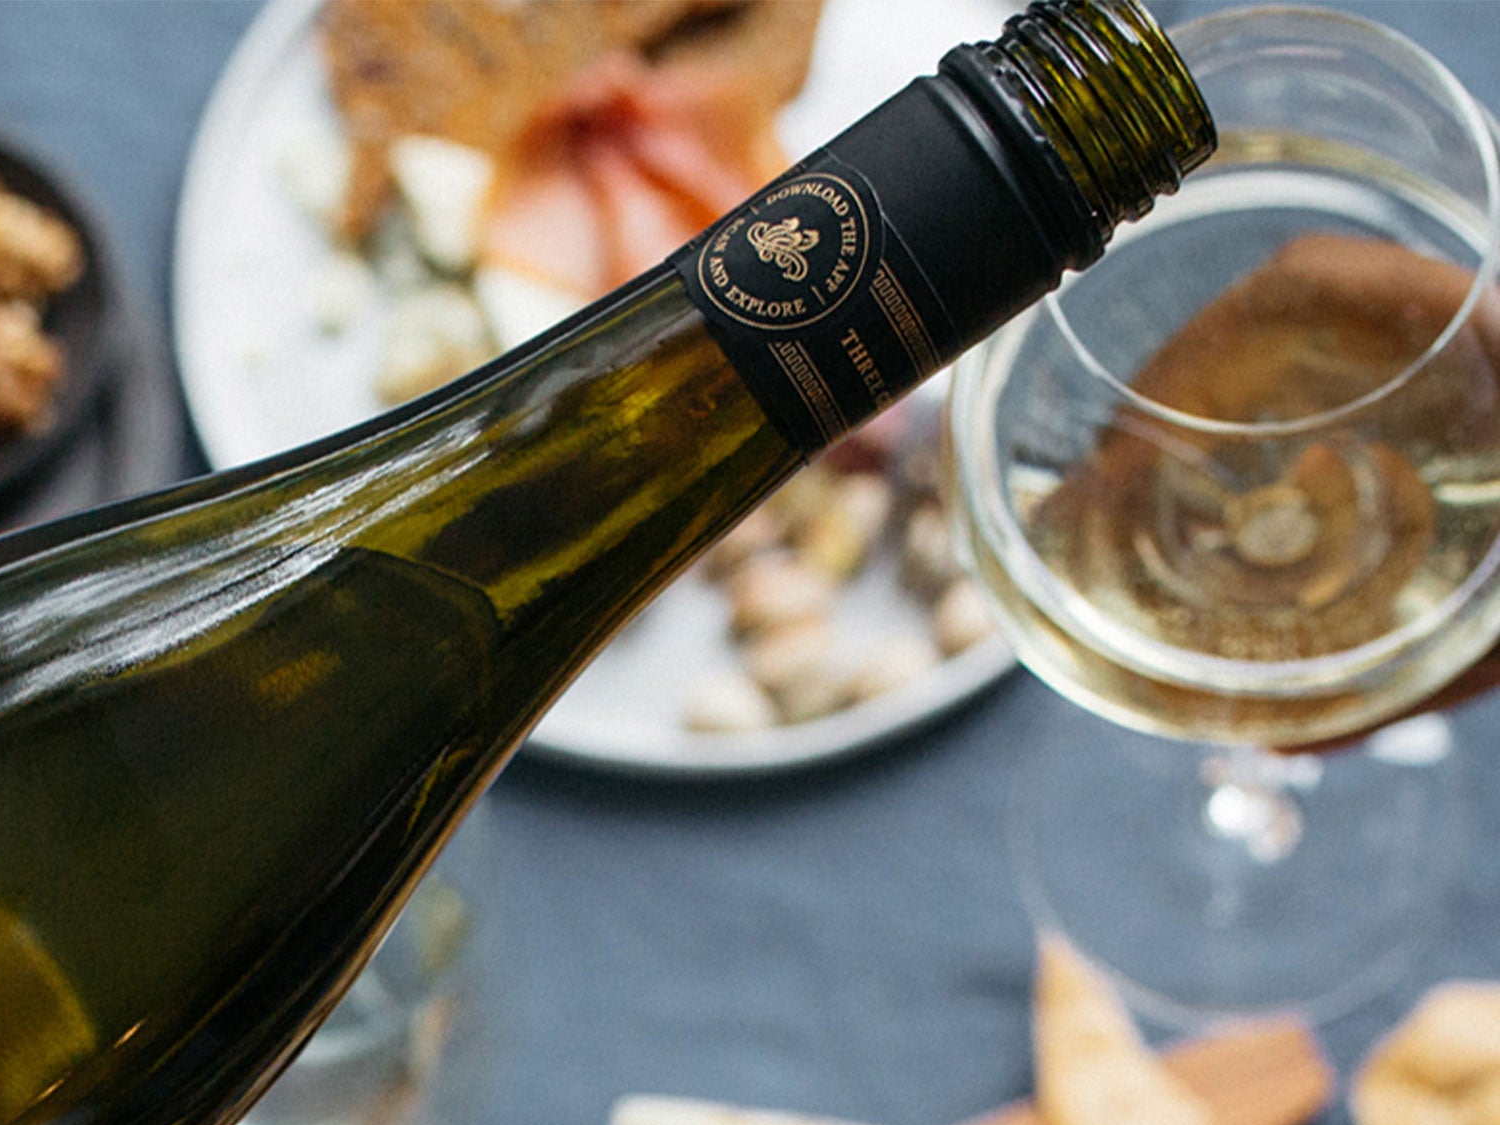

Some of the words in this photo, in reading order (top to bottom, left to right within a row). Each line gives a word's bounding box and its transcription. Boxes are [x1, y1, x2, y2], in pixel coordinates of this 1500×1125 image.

[765, 182, 848, 216] DOWNLOAD
[840, 217, 857, 257] THE
[710, 257, 729, 288] AND
[725, 286, 806, 317] EXPLORE
[826, 257, 851, 293] APP
[840, 328, 885, 395] THREE
